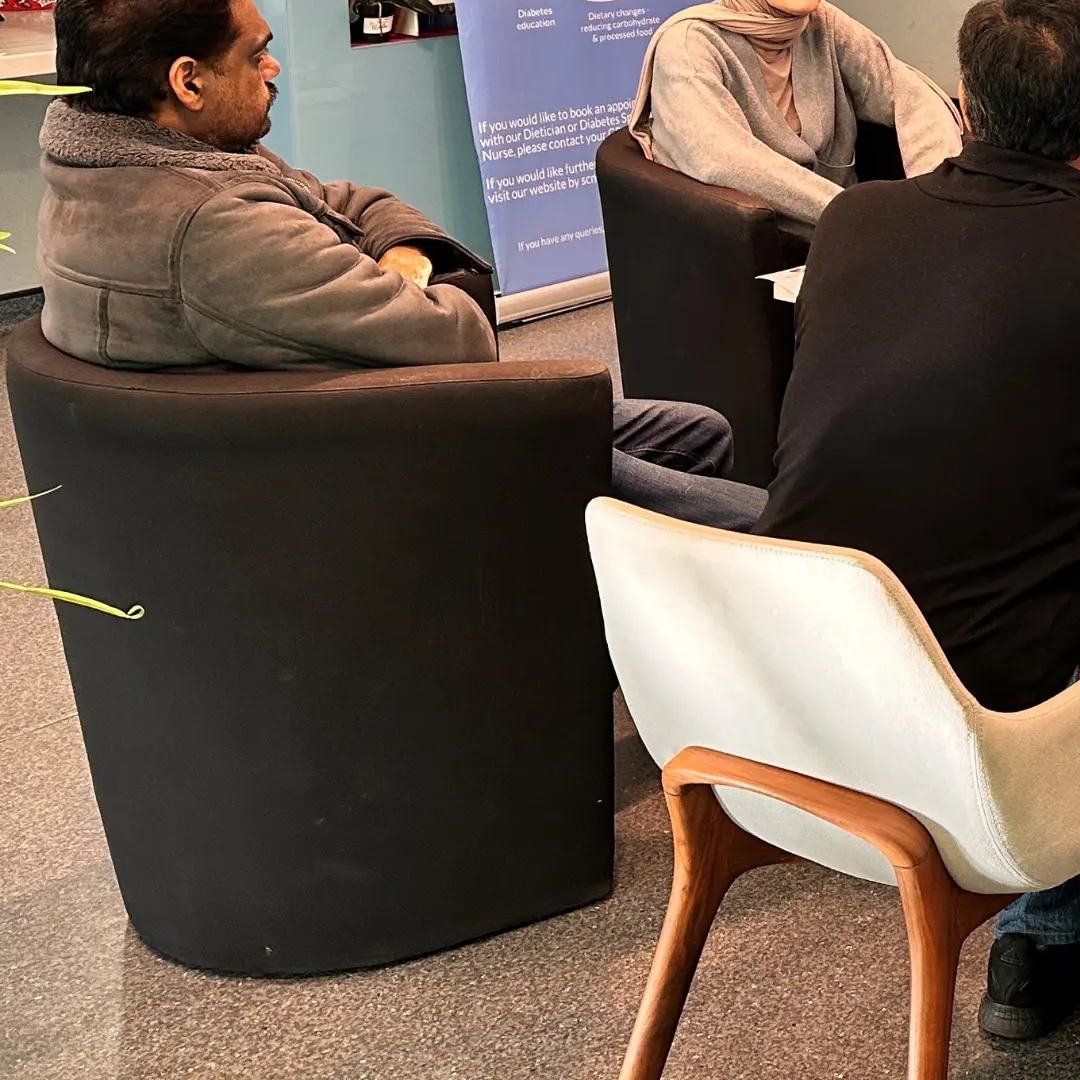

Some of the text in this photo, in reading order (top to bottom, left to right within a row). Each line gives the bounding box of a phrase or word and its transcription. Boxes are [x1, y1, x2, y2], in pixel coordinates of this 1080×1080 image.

[517, 7, 553, 19] Diabetes
[588, 10, 615, 21] Dietary
[615, 7, 645, 18] changes
[516, 19, 556, 31] education
[580, 17, 660, 32] reducing carbohydrate
[592, 27, 653, 43] & processed food
[478, 104, 606, 134] If you would like to book an
[479, 134, 504, 148] with
[505, 132, 522, 143] our
[523, 124, 566, 141] Dietician
[567, 123, 578, 133] or
[579, 116, 620, 131] Diabetes
[482, 148, 517, 162] Nurse,
[517, 142, 547, 158] please
[548, 133, 585, 150] contact
[585, 131, 606, 145] your
[486, 166, 564, 190] If you would like
[487, 177, 580, 204] visit our website by
[518, 240, 524, 251] If
[525, 240, 540, 252] you
[540, 235, 560, 246] have
[560, 232, 574, 242] any
